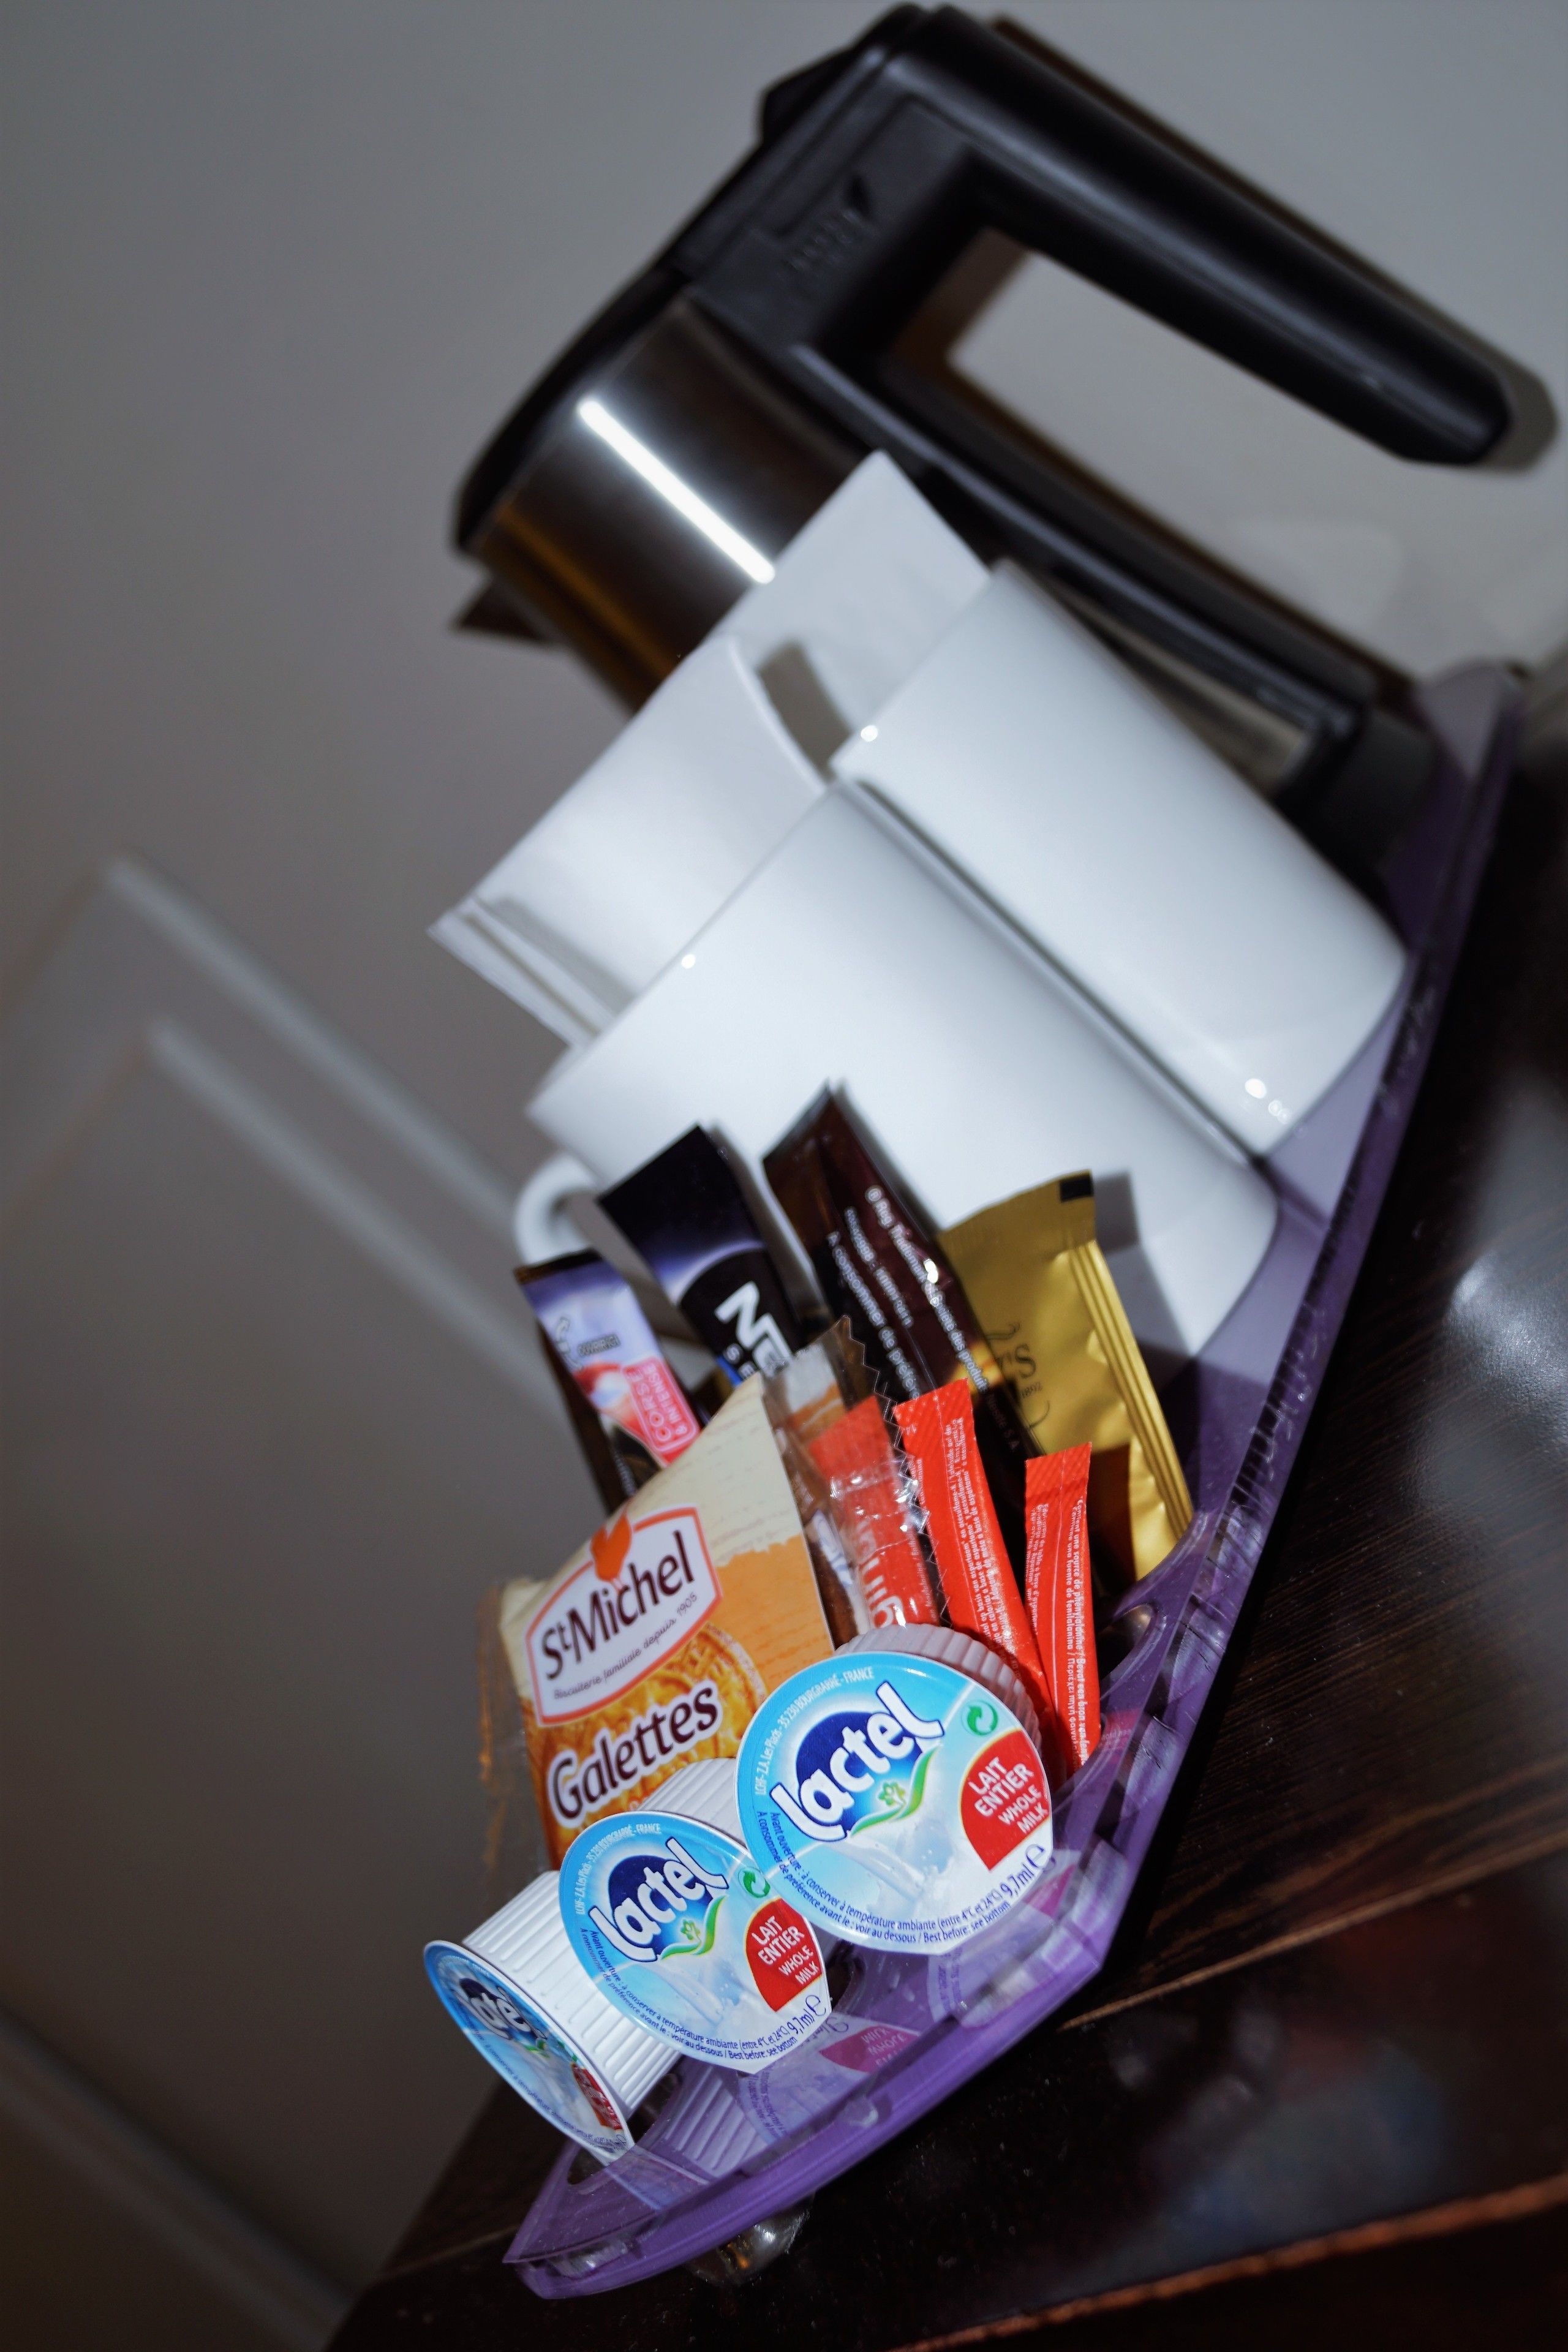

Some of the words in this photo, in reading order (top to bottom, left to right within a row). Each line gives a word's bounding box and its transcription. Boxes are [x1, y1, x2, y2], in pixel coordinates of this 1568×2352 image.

[832, 1246, 887, 1327] consommer
[880, 1327, 897, 1349] de
[949, 1329, 969, 1351] des
[643, 1363, 682, 1424] INTENSE
[969, 1506, 978, 1515] de
[1068, 1506, 1077, 1540] Contiene
[959, 1528, 967, 1539] en
[971, 1516, 982, 1533] base
[974, 1560, 983, 1570] de
[971, 1579, 981, 1593] van
[976, 1570, 987, 1588] base
[1073, 1579, 1082, 1589] de
[973, 1593, 985, 1612] basis
[1066, 1587, 1074, 1597] de
[990, 1622, 998, 1632] en
[554, 1673, 601, 1700] Biscuiterie
[605, 1646, 643, 1684] familiale
[644, 1618, 677, 1649] depuis
[676, 1591, 698, 1616] 1905
[1076, 1657, 1085, 1682] Bevat
[783, 1702, 800, 1720] 230
[841, 1665, 875, 1683] FRANCE
[1078, 1700, 1087, 1721] bron
[552, 1686, 721, 1817] Galettes
[771, 1681, 943, 1842] lactel
[968, 1757, 1007, 1795] LAIT
[973, 1762, 1035, 1818] ENTIER
[998, 1784, 1042, 1825] WHOLE
[635, 1823, 661, 1834] FRANCE
[1017, 1803, 1049, 1834] MILK
[758, 1817, 783, 1863] consommer
[769, 1812, 783, 1835] Avant
[777, 1833, 802, 1871] ouverture
[805, 1878, 839, 1907] conserver
[845, 1904, 895, 1929] température
[897, 1920, 936, 1929] ambiante
[975, 1905, 983, 1913] et
[999, 1862, 1035, 1896] 9,7ml
[778, 1862, 791, 1874] de
[590, 1838, 730, 1962] lactel
[784, 1874, 821, 1907] préférence
[819, 1905, 841, 1923] avant
[984, 1900, 1011, 1925] bottom
[750, 1915, 782, 1946] LAIT
[854, 1924, 870, 1933] voir
[871, 1929, 883, 1938] au
[883, 1931, 917, 1942] dessous
[924, 1931, 940, 1942] Best
[971, 1920, 984, 1931] see
[756, 1924, 805, 1966] ENTIER
[778, 1944, 814, 1976] WHOLE
[794, 1960, 820, 1985] MILK
[582, 1932, 605, 1973] consommer
[602, 1972, 612, 1983] de
[608, 1982, 641, 2015] préférence
[639, 2012, 660, 2029] avant
[670, 2034, 685, 2043] voir
[684, 2040, 695, 2048] au
[695, 2043, 724, 2056] dessous
[778, 2037, 797, 2051] bottom
[589, 1931, 602, 1950] Avant
[598, 1948, 621, 1983] ouverture
[625, 1989, 656, 2017] conserver
[662, 2016, 704, 2043] température
[706, 2037, 738, 2048] ambiante
[786, 2007, 815, 2034] 9,7ml
